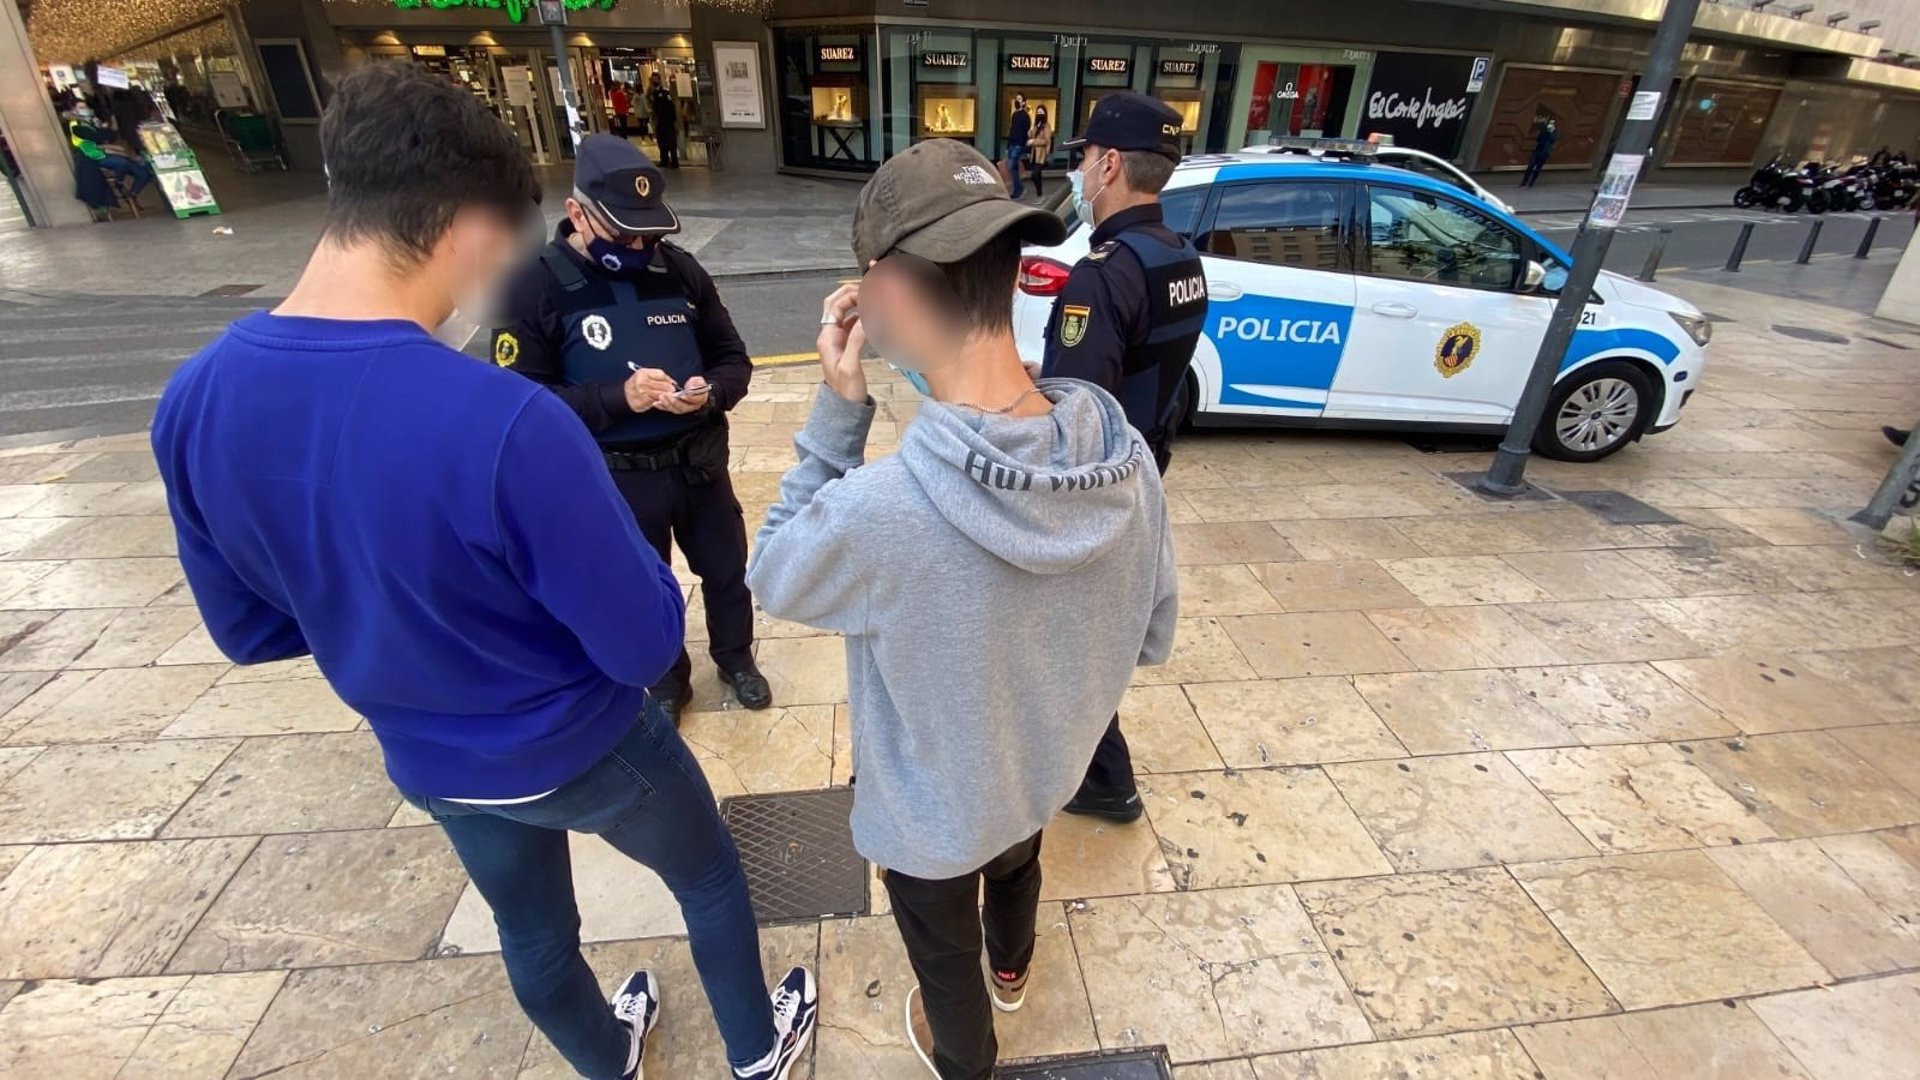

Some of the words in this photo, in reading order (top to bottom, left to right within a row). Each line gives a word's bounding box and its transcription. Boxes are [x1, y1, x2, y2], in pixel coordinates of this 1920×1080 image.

[821, 47, 854, 60] SUAREZ
[925, 53, 967, 66] SUAREZ
[1011, 56, 1050, 69] SUAREZ
[1090, 59, 1126, 72] SUAREZ
[1163, 62, 1195, 74] SUAREZ
[1369, 91, 1386, 119] El
[1385, 92, 1421, 119] Corte
[1169, 276, 1206, 307] POLICIA
[647, 314, 687, 326] POLICIA
[1217, 316, 1340, 345] POLICIA
